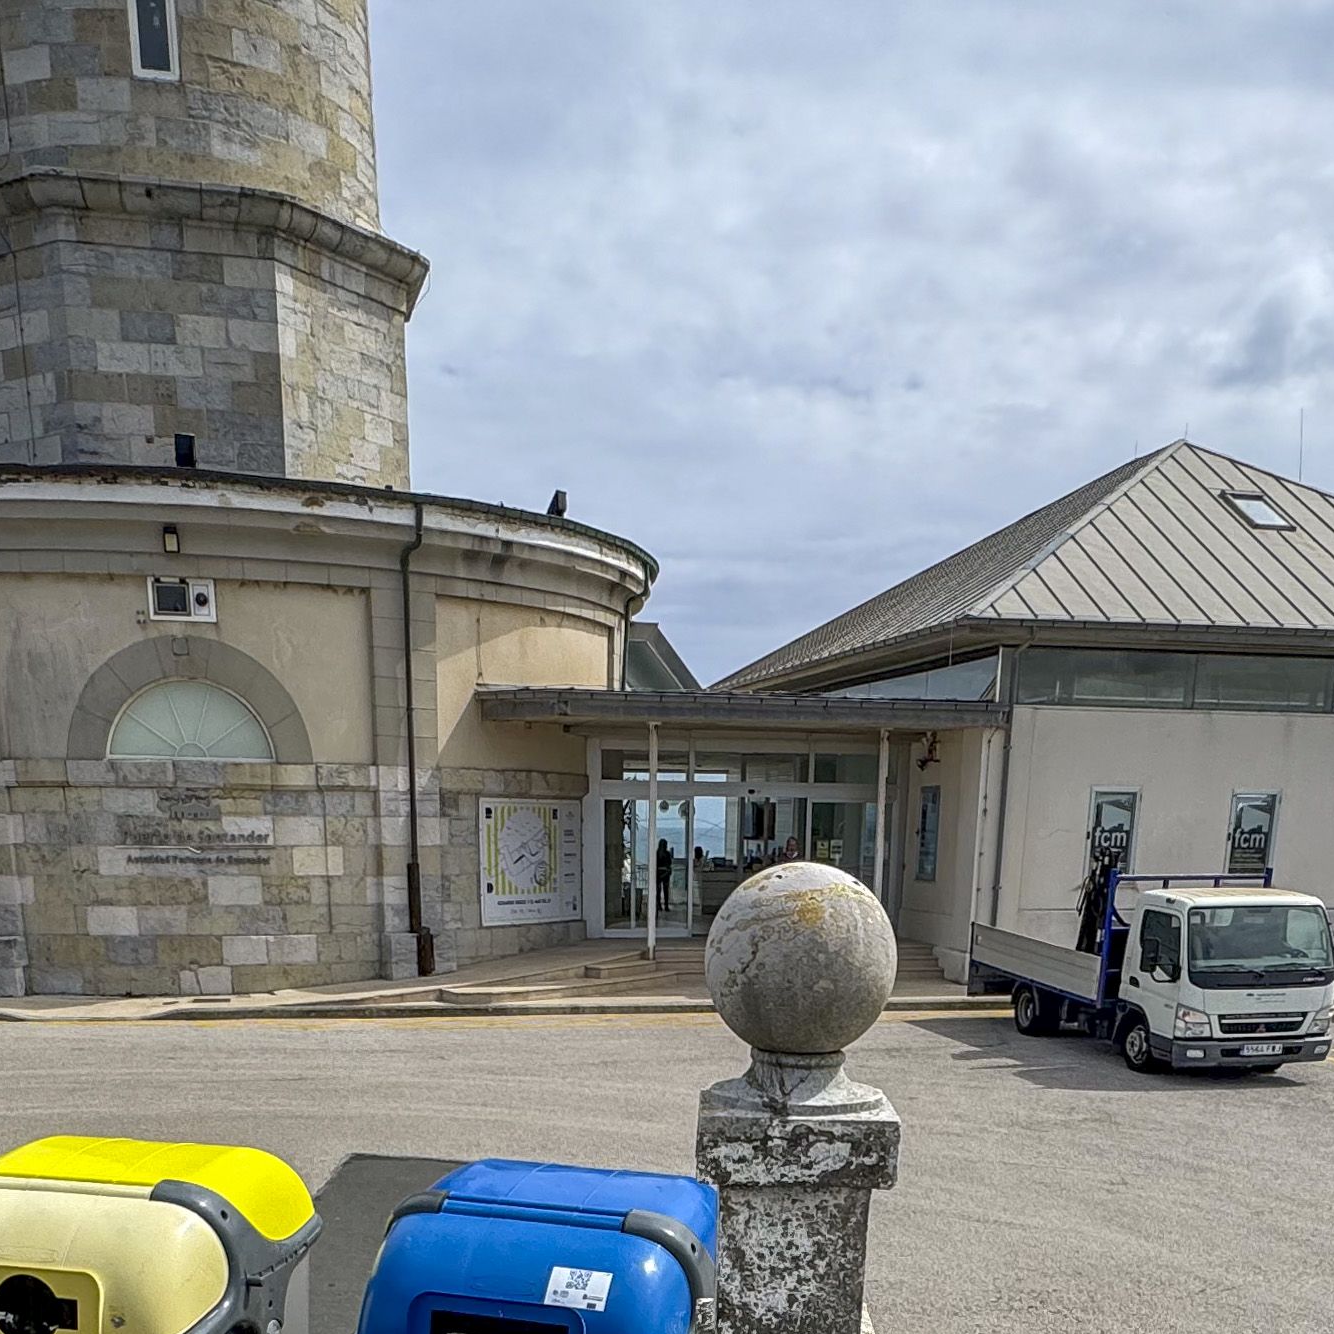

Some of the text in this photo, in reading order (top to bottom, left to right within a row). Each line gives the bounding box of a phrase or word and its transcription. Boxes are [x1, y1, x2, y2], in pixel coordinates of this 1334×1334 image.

[197, 830, 270, 844] Santander
[1094, 826, 1127, 847] fcm
[1234, 827, 1265, 848] fcm
